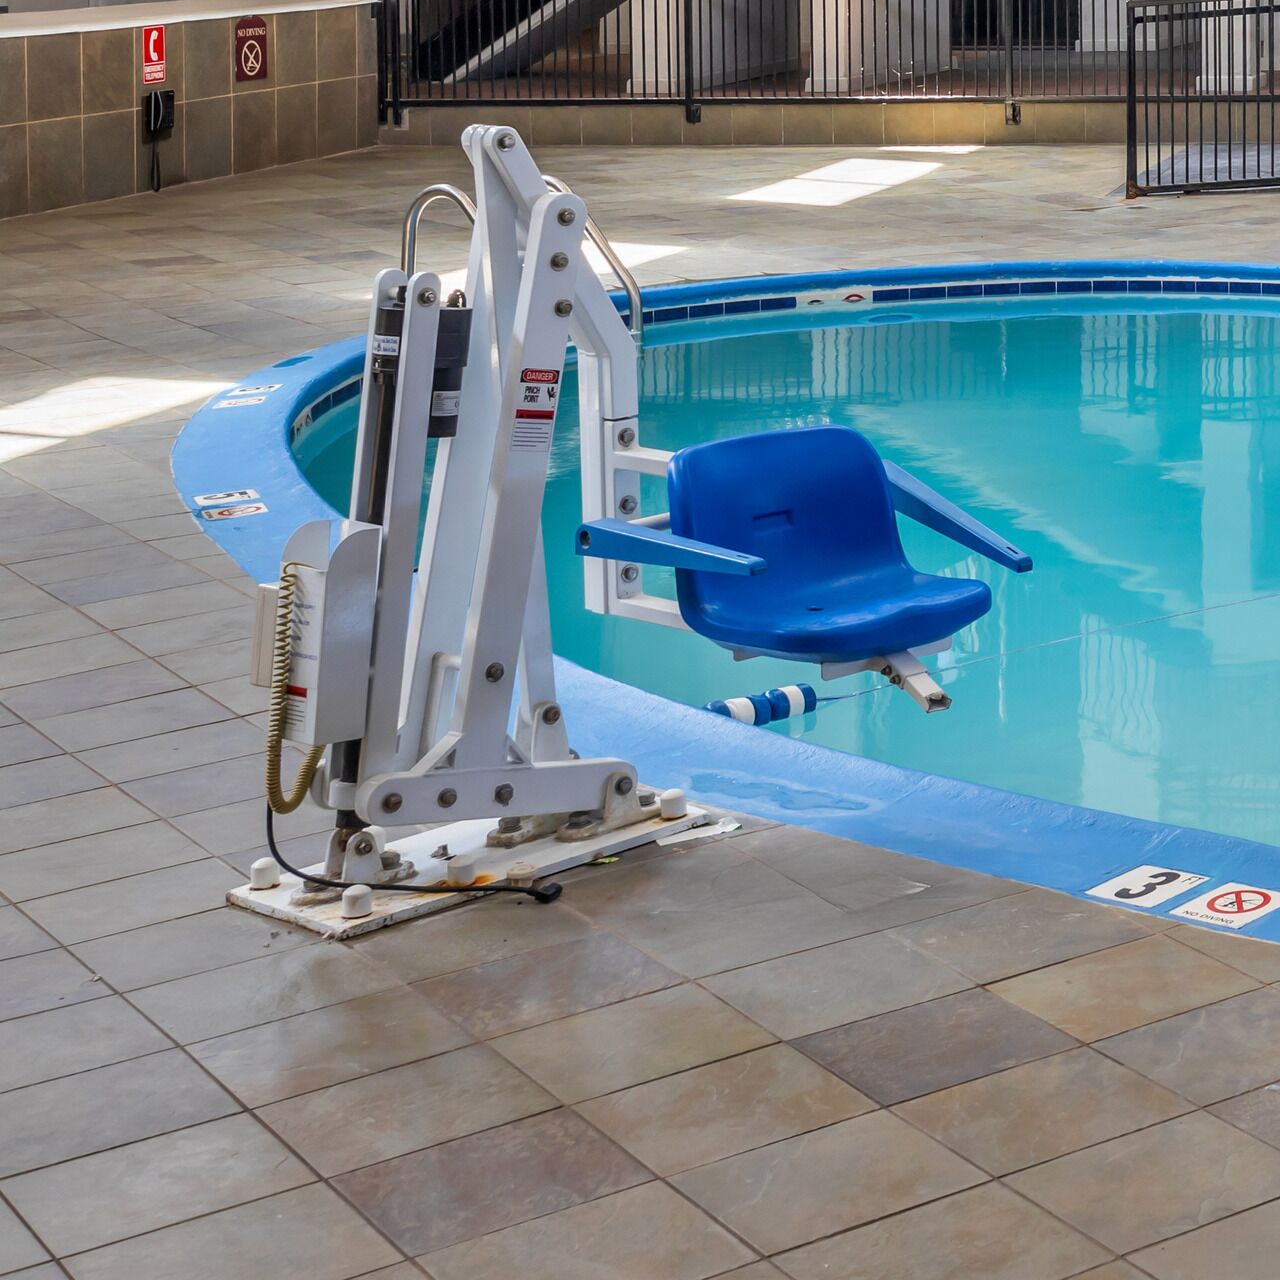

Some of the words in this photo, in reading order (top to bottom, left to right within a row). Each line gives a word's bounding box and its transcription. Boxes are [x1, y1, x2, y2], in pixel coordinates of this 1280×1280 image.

[237, 28, 246, 38] NO
[246, 26, 266, 37] DIVING
[526, 371, 554, 380] DANGER
[524, 386, 541, 395] PINCH
[523, 394, 540, 403] POINT
[1114, 872, 1180, 899] 3
[1181, 875, 1204, 885] FT
[1182, 909, 1199, 918] NO
[1200, 914, 1235, 925] DIVING
